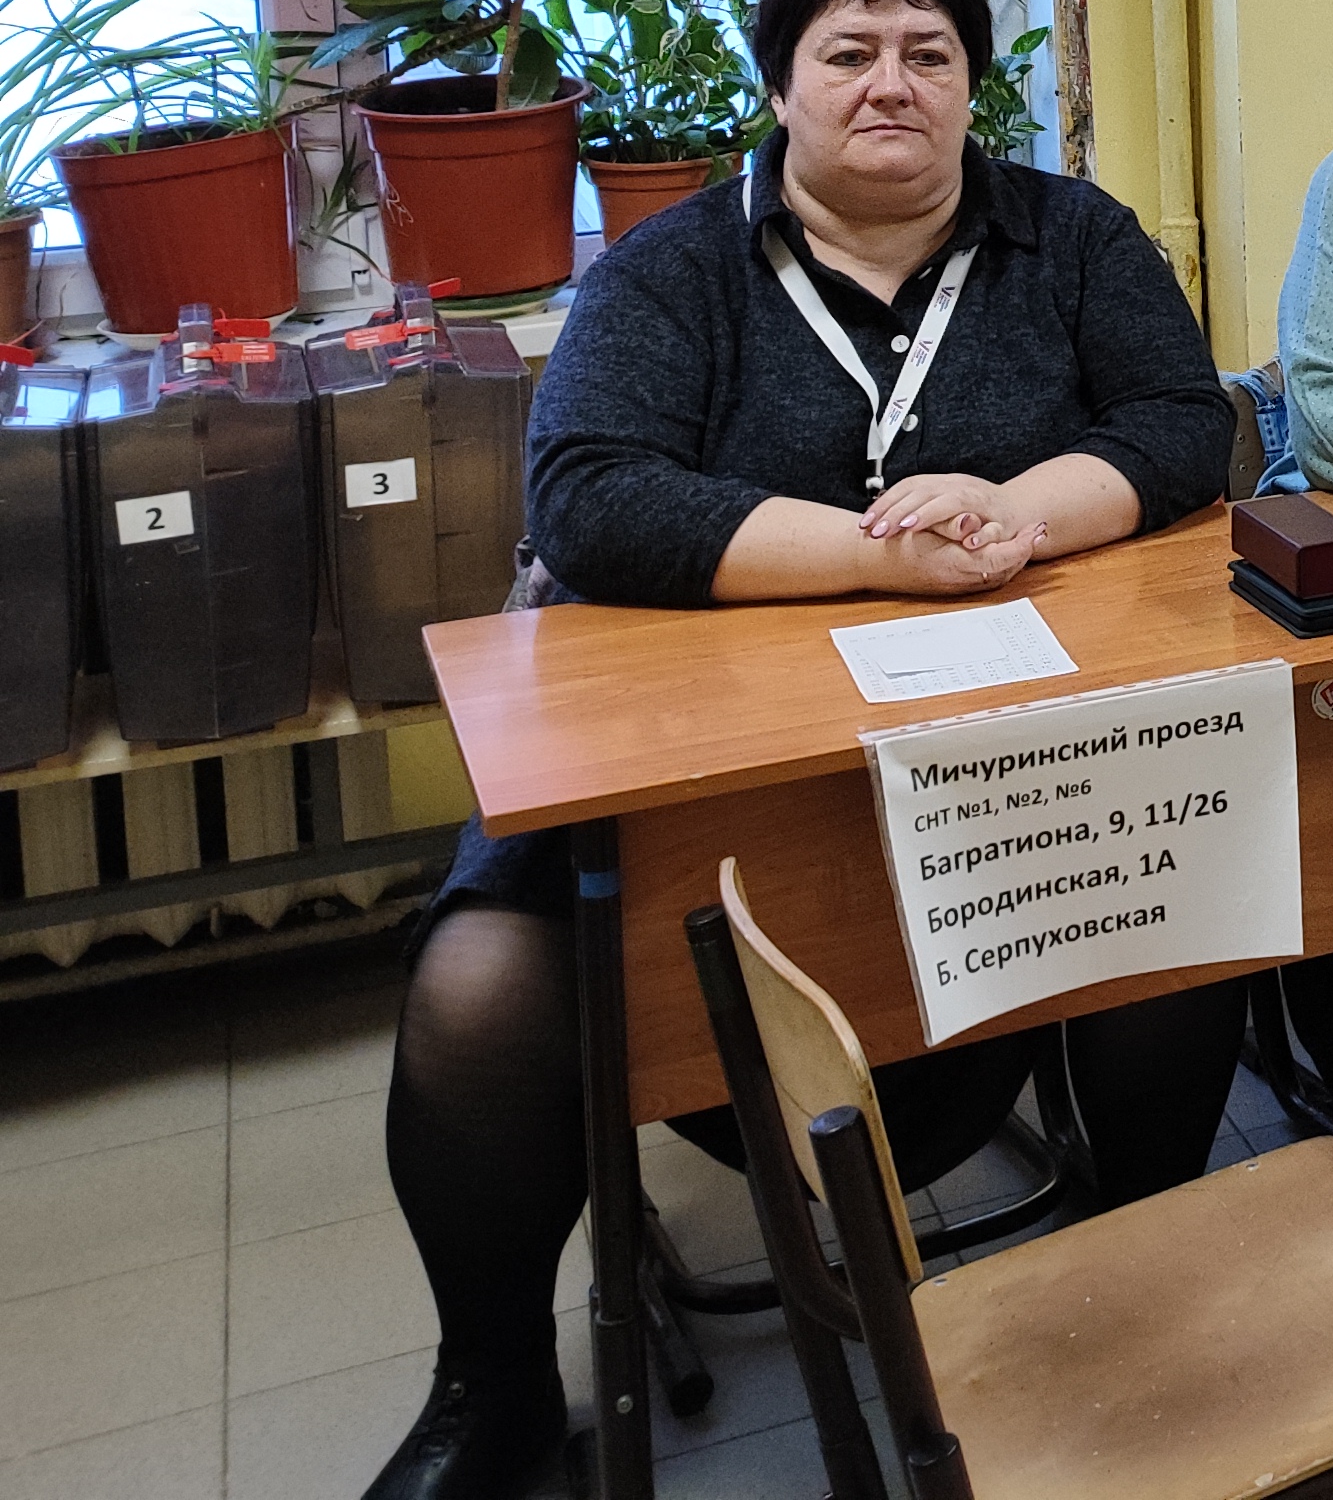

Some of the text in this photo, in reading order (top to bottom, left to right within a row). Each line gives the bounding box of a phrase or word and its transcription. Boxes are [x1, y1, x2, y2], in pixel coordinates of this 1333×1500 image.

[145, 507, 166, 531] 2
[371, 472, 390, 496] 3
[910, 709, 1244, 792] Мичуринский проезд
[914, 778, 1093, 834] СНТ №1, №2, №6
[919, 789, 1229, 882] Багратиона, 9, 11/26
[927, 849, 1177, 934] Бородинская, 1А
[936, 904, 1167, 987] Б. Серпуховская
